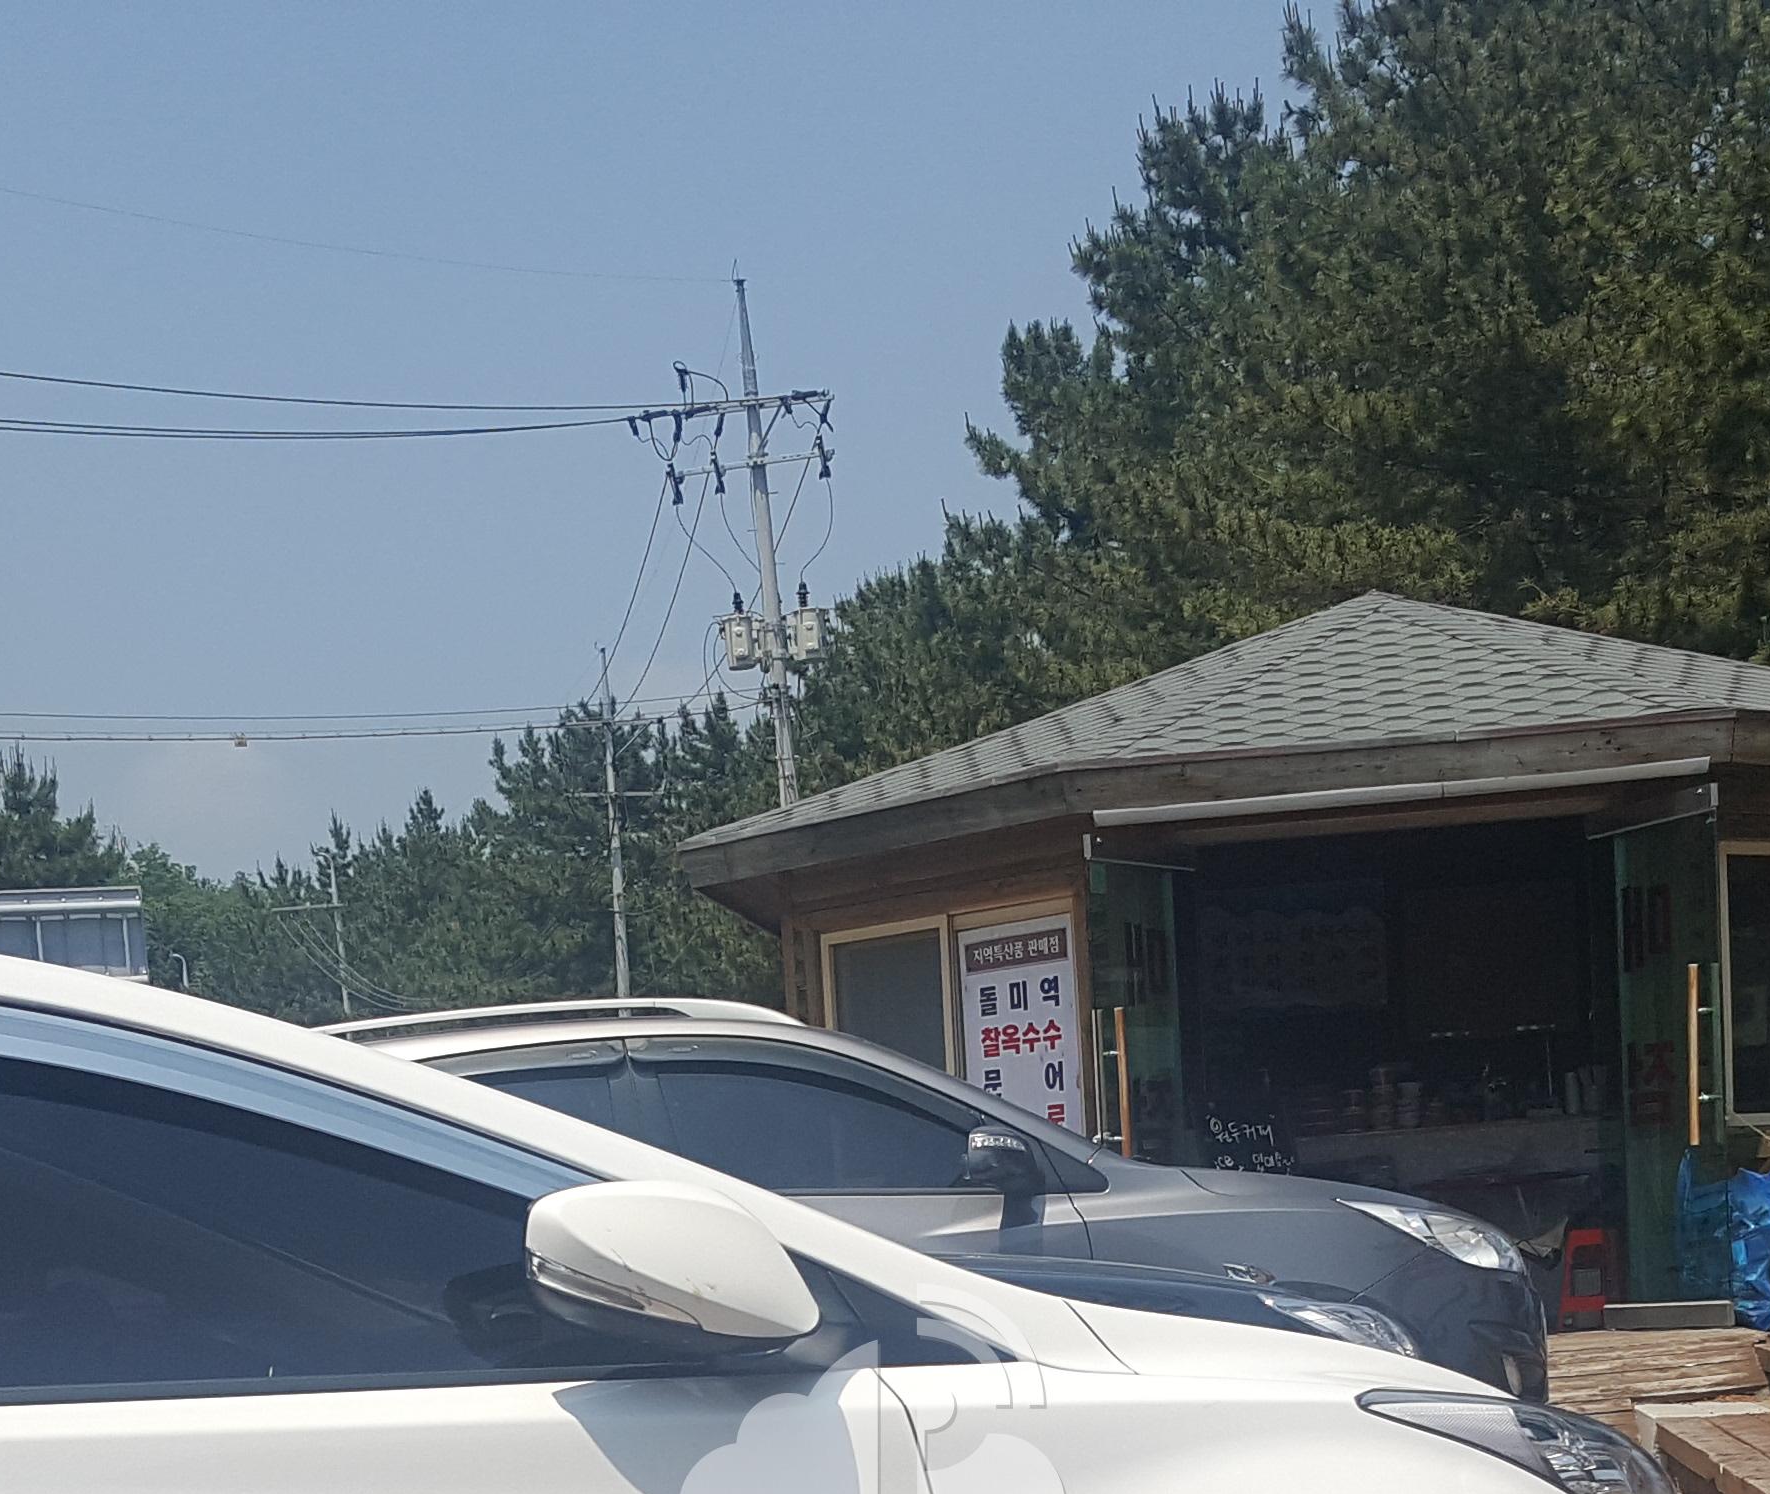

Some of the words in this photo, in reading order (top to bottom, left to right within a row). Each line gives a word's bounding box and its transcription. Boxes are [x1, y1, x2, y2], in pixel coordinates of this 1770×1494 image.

[1028, 935, 1059, 956] 판매점
[979, 975, 1060, 1017] 돌미역
[981, 1019, 1062, 1058] 찰옥수수
